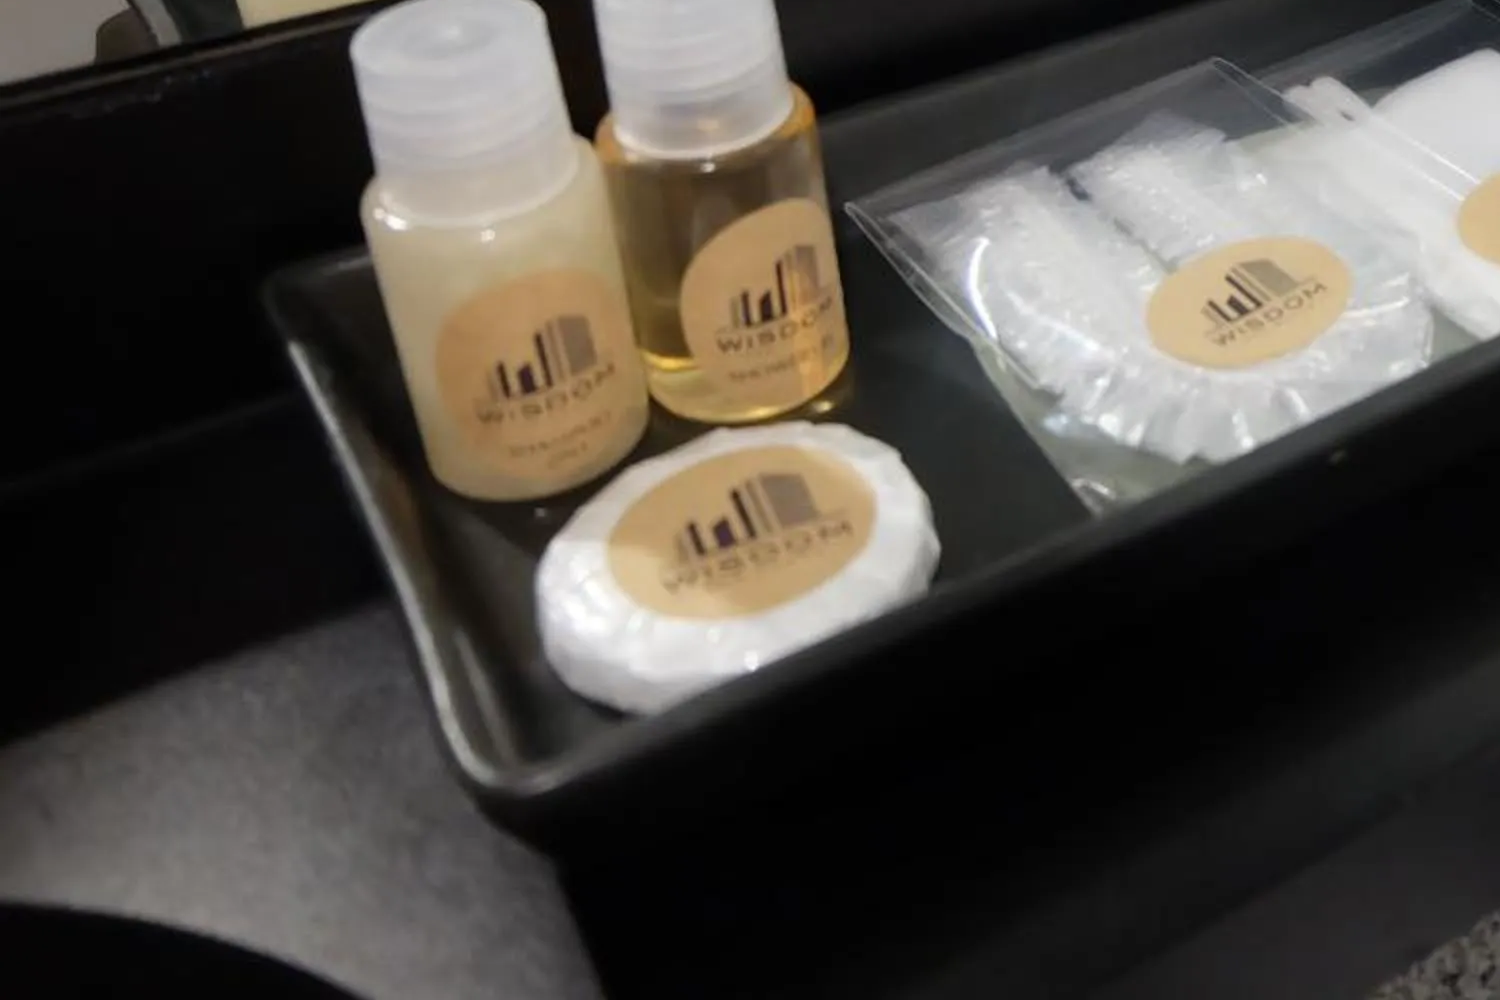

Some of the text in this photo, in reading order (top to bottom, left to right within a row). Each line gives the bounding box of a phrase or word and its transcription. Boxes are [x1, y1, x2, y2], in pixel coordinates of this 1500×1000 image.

[715, 297, 833, 353] WISDOM
[1209, 281, 1328, 347] WISDOM
[476, 361, 616, 425] WISDOM
[663, 519, 853, 595] WISDOM
